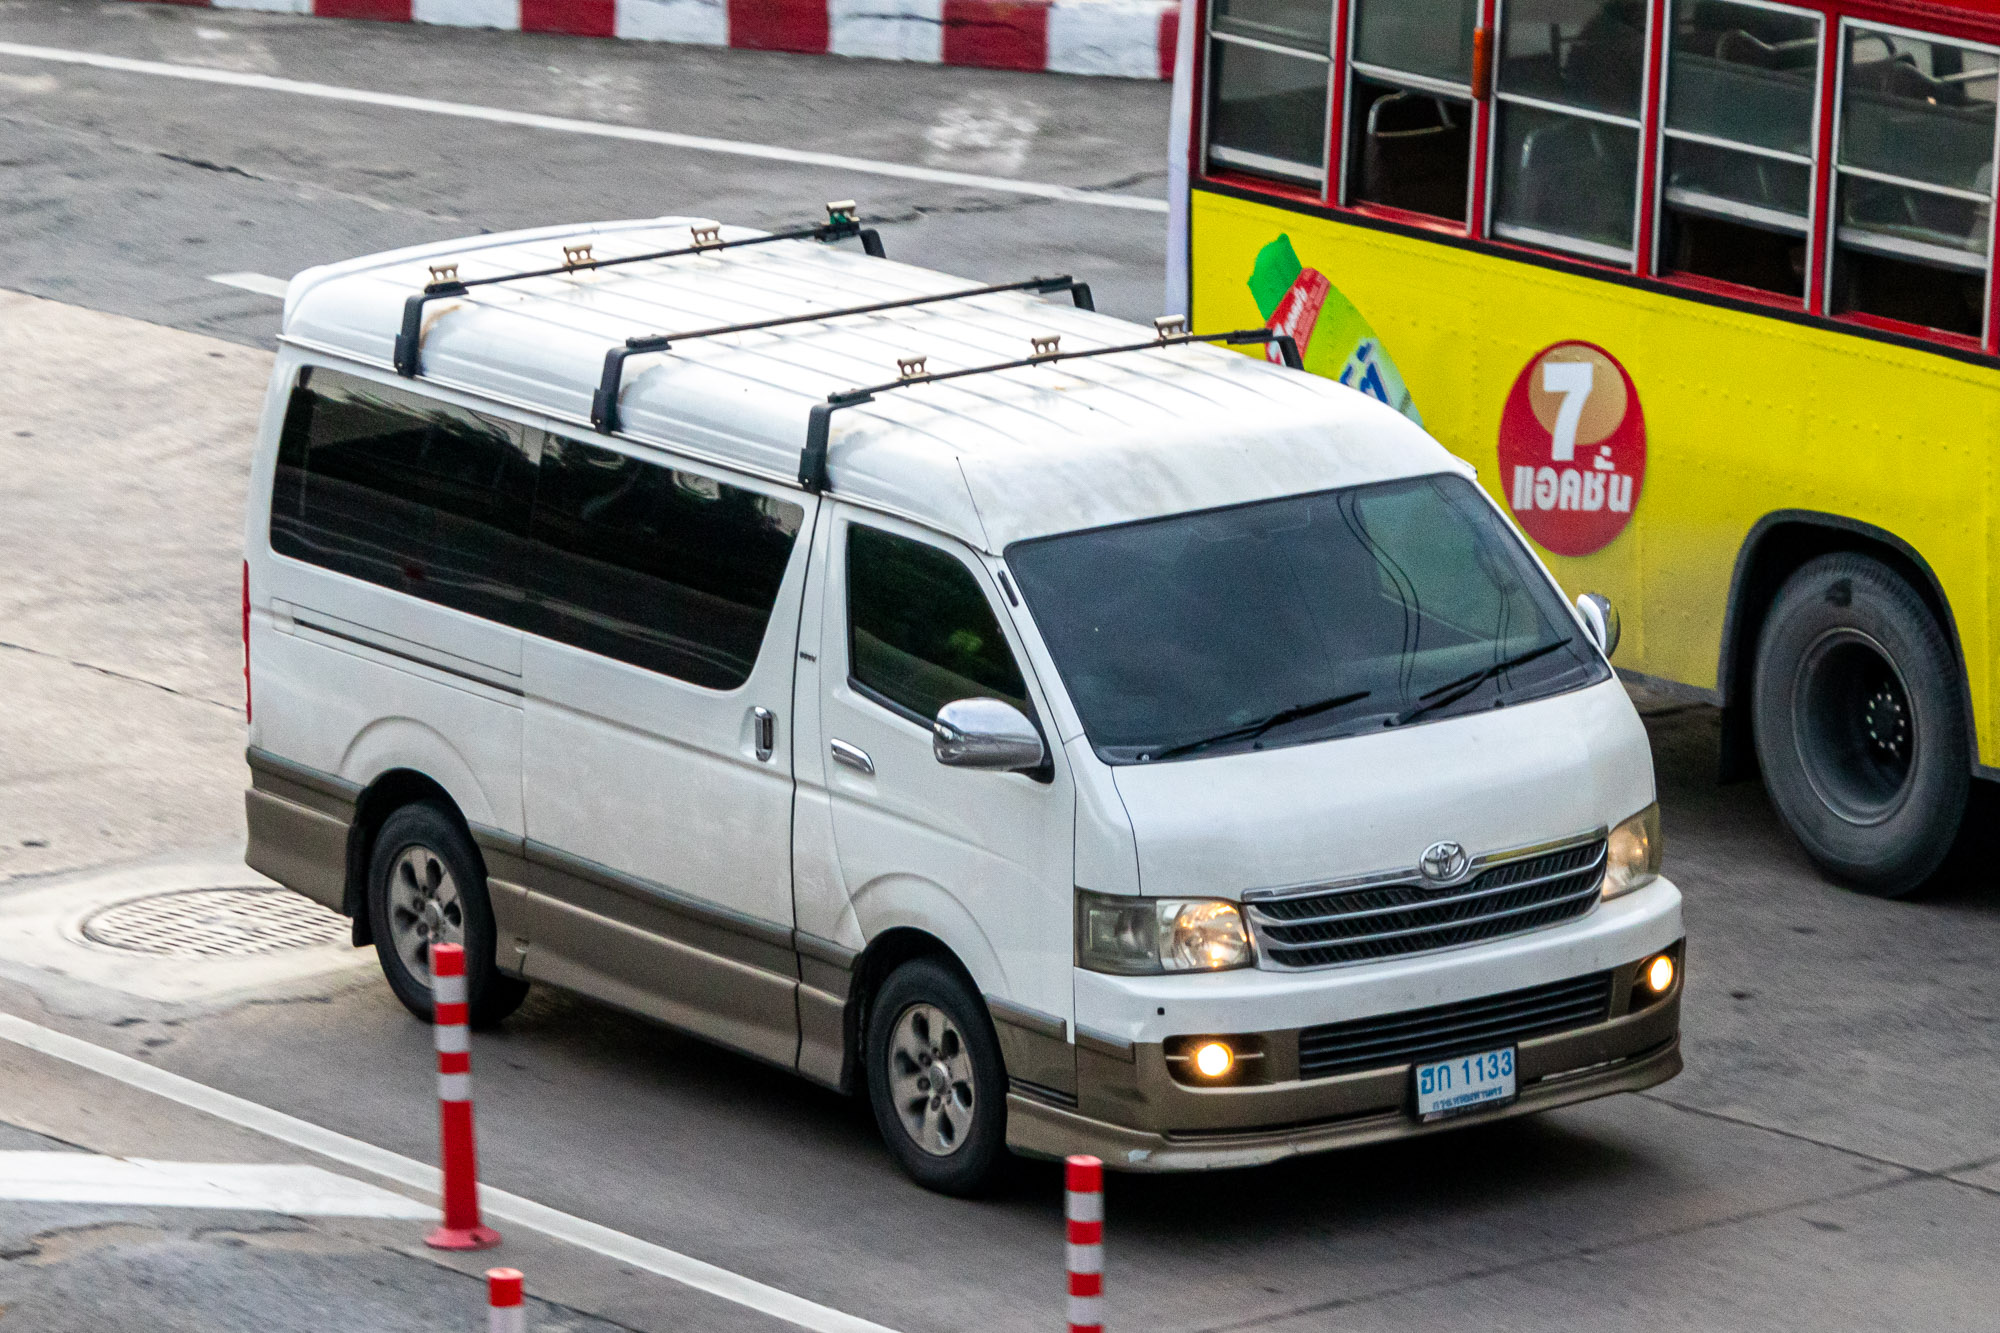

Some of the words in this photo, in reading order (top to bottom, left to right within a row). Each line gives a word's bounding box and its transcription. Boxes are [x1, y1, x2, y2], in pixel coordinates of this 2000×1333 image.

[1543, 362, 1593, 461] 7
[1513, 445, 1633, 512] แอคชั่น
[1462, 1050, 1513, 1085] 1133
